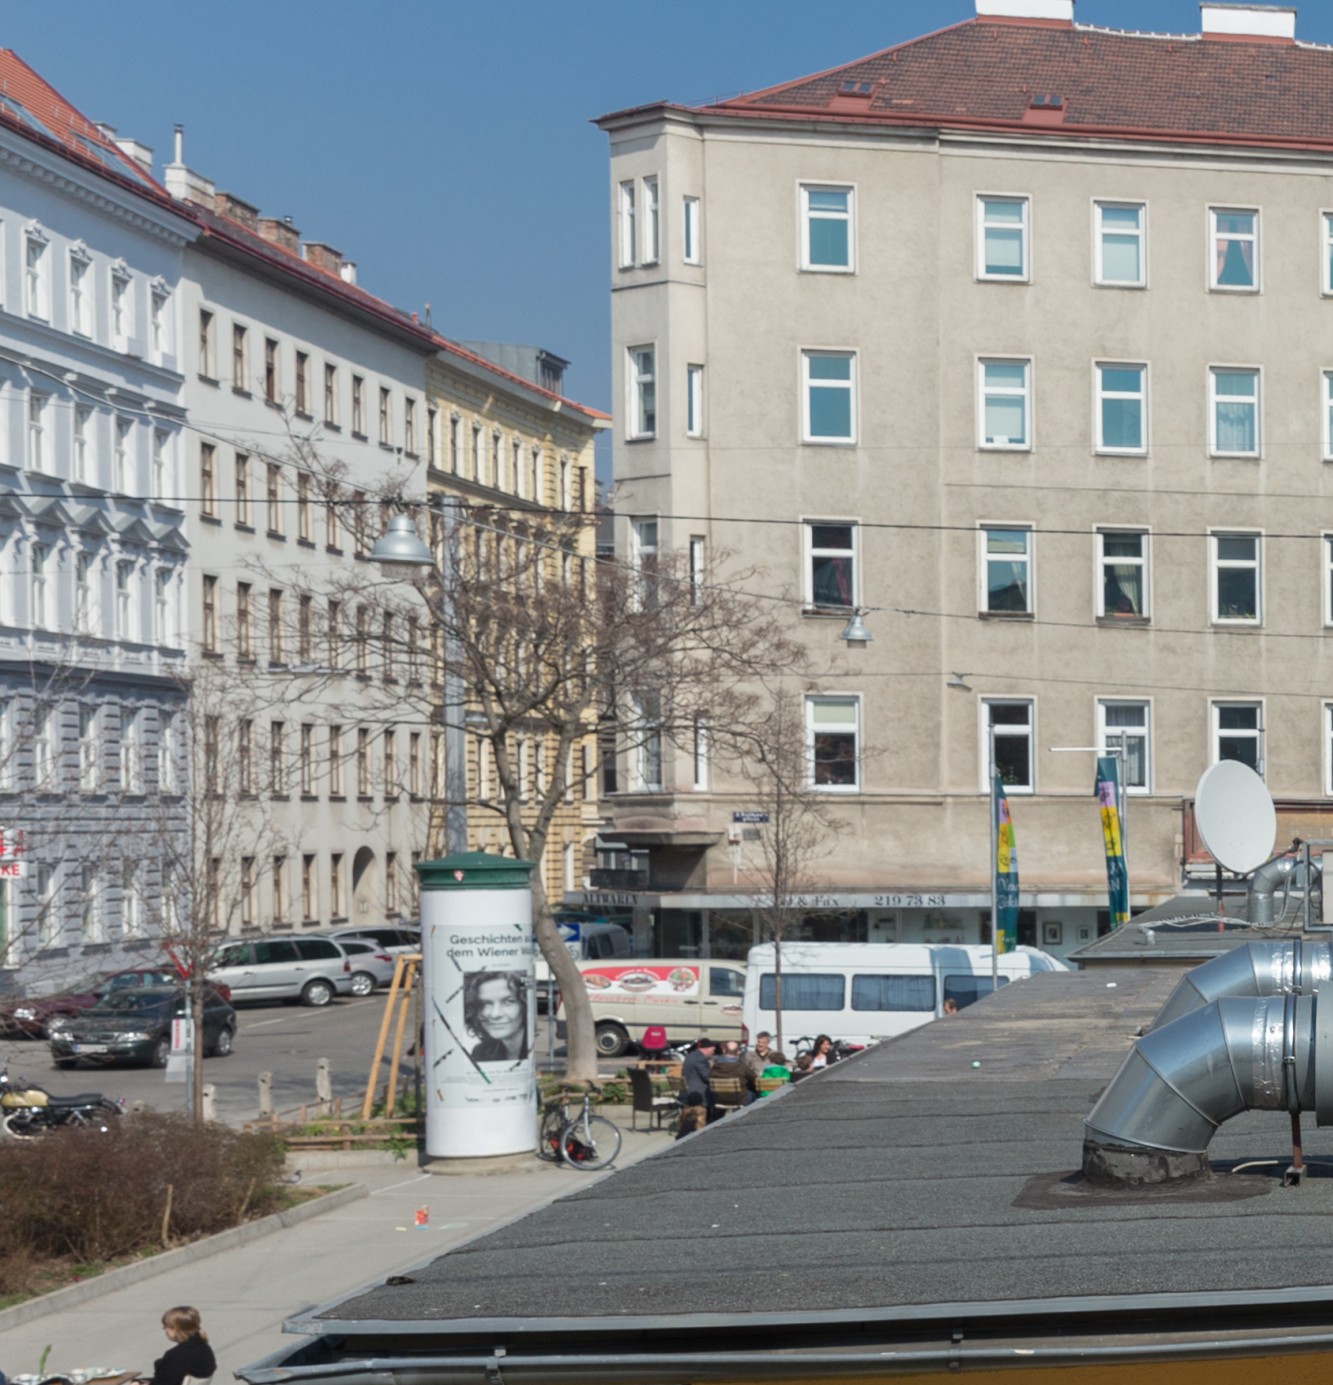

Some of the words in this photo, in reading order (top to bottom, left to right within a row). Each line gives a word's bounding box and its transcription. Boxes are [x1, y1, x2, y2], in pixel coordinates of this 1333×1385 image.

[874, 894, 902, 906] 219
[906, 894, 924, 906] 73
[928, 894, 946, 906] 83
[450, 934, 523, 945] Geschichten
[446, 947, 474, 957] dem
[477, 946, 519, 957] Wiener
